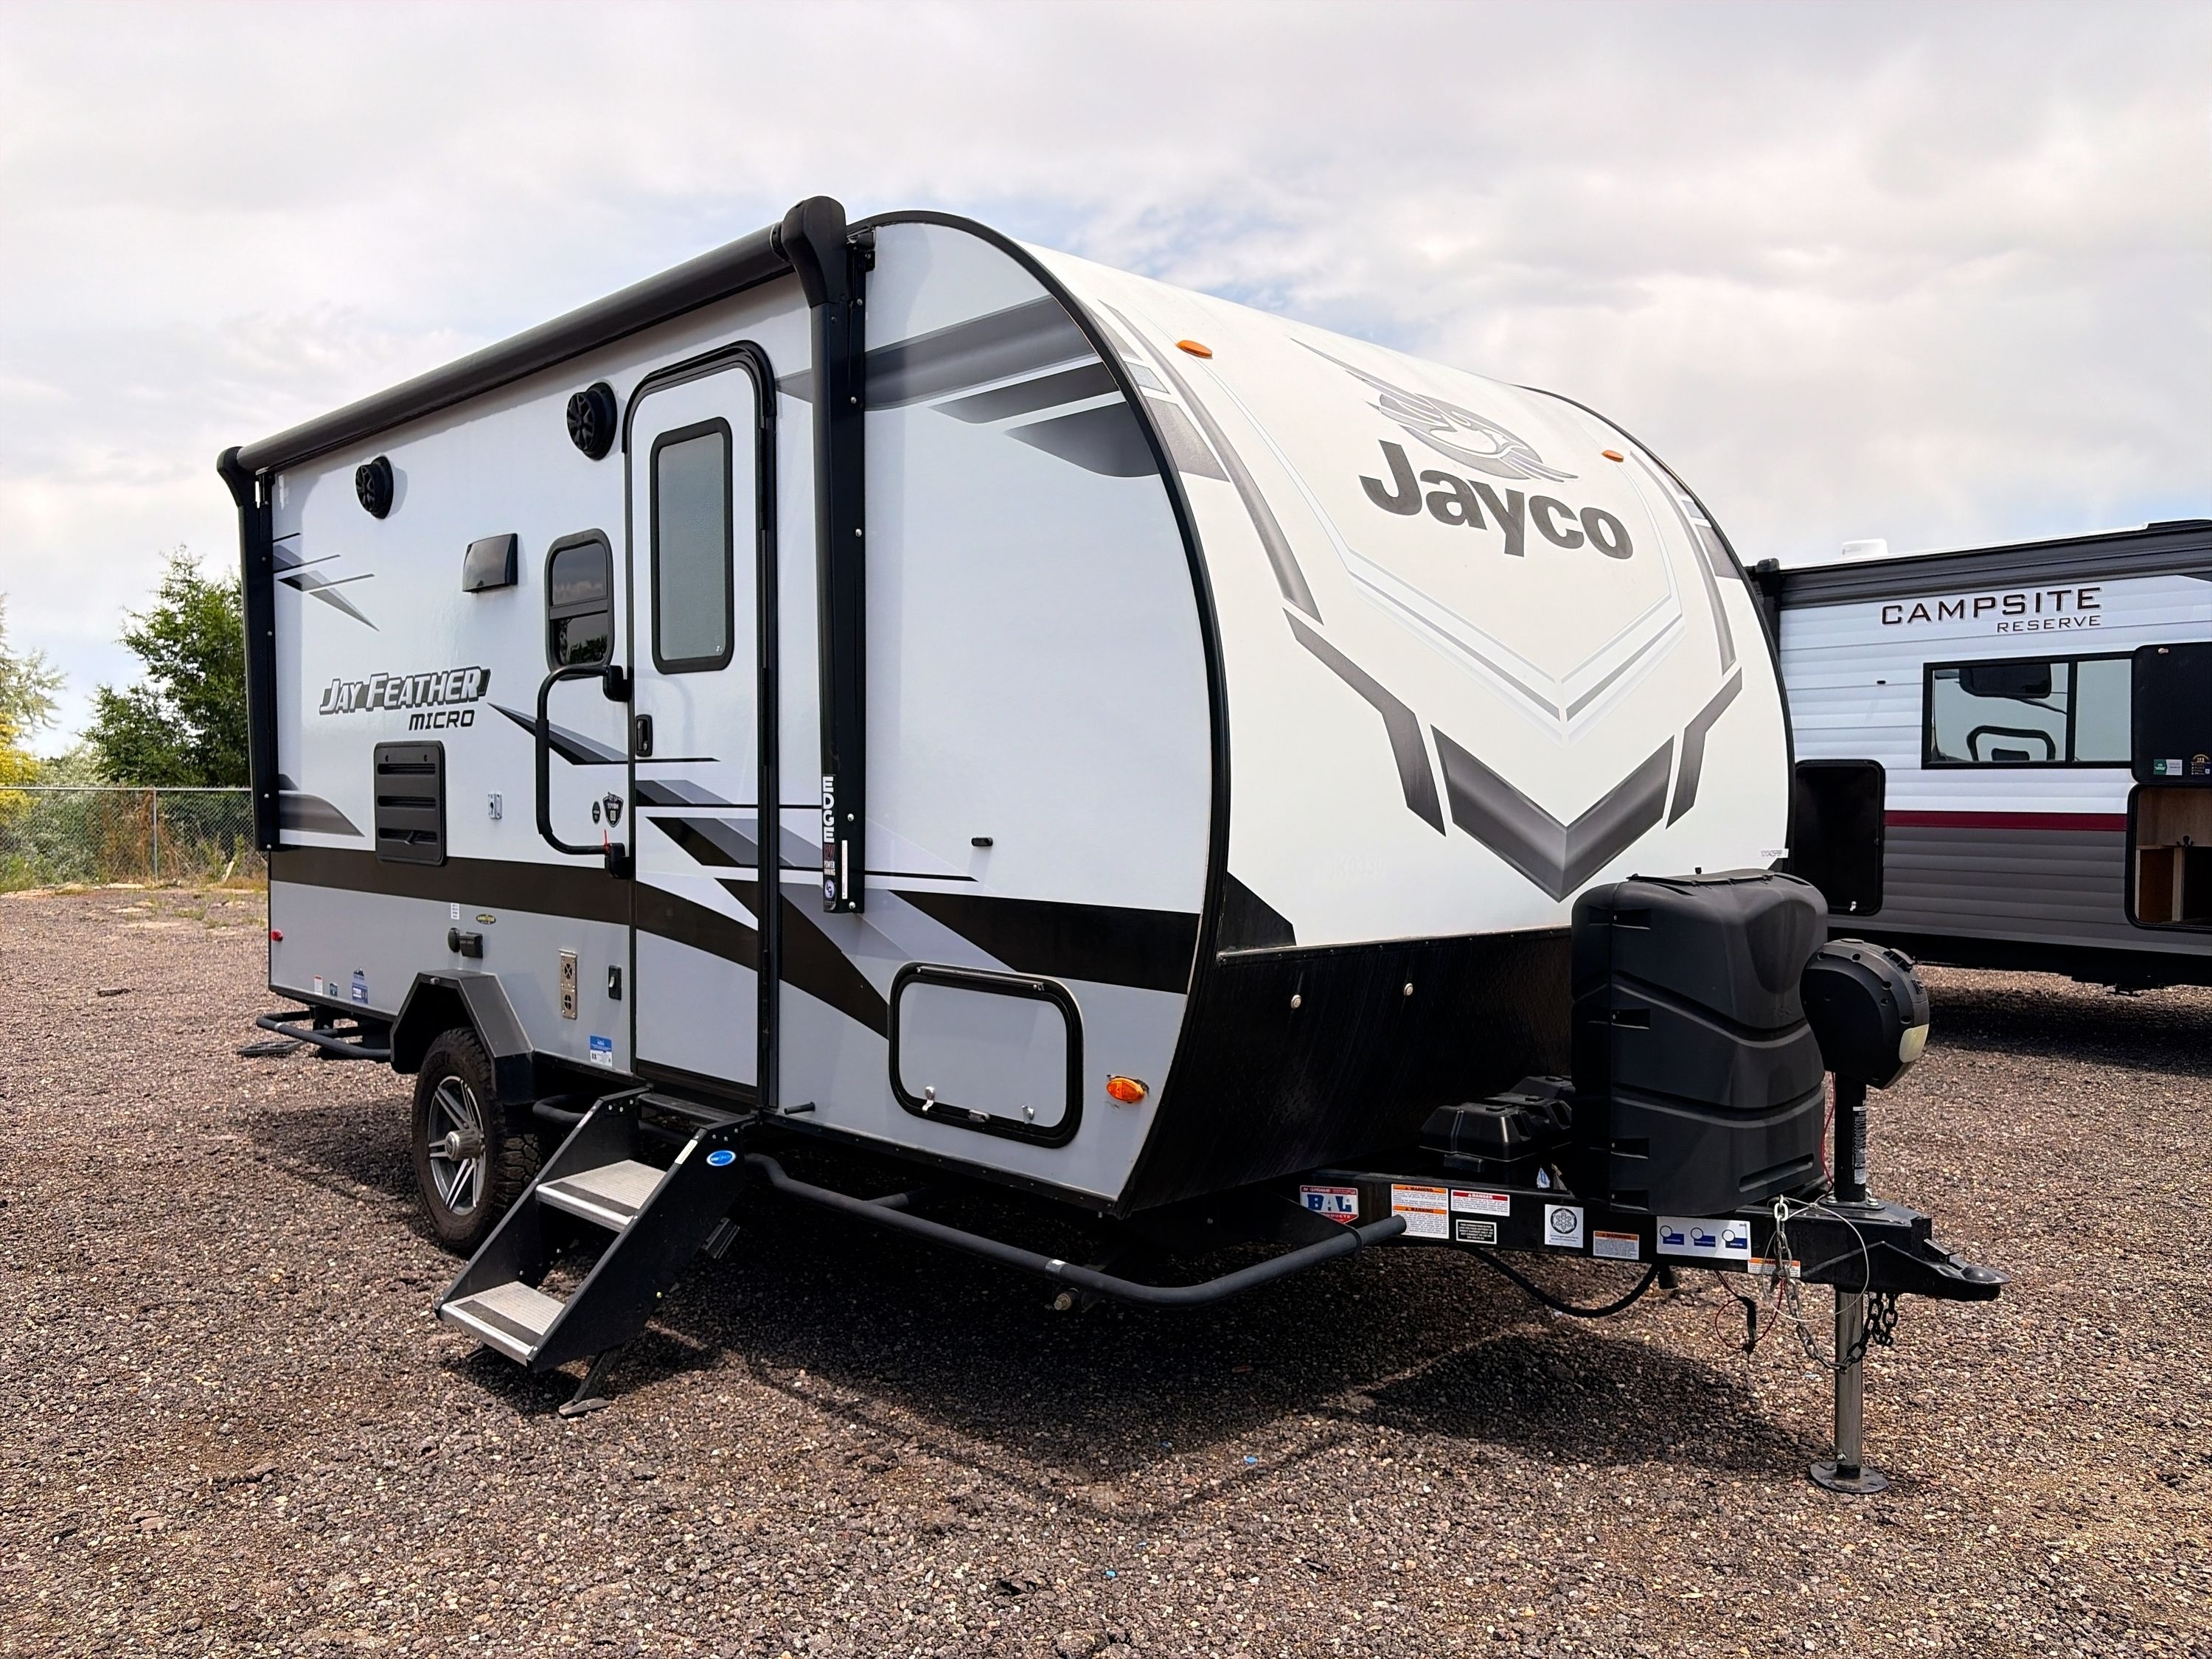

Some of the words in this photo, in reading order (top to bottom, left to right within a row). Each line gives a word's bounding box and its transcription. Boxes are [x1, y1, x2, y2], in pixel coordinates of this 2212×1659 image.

[1358, 439, 1633, 560] Jayco
[1882, 588, 2101, 625] CAMPSITE
[1997, 615, 2101, 633] RESERVE
[319, 678, 364, 714] JAY
[366, 666, 482, 712] FEATHER
[408, 709, 475, 731] MICRO
[822, 776, 835, 843] EDGE
[1307, 1194, 1352, 1213] BAL
